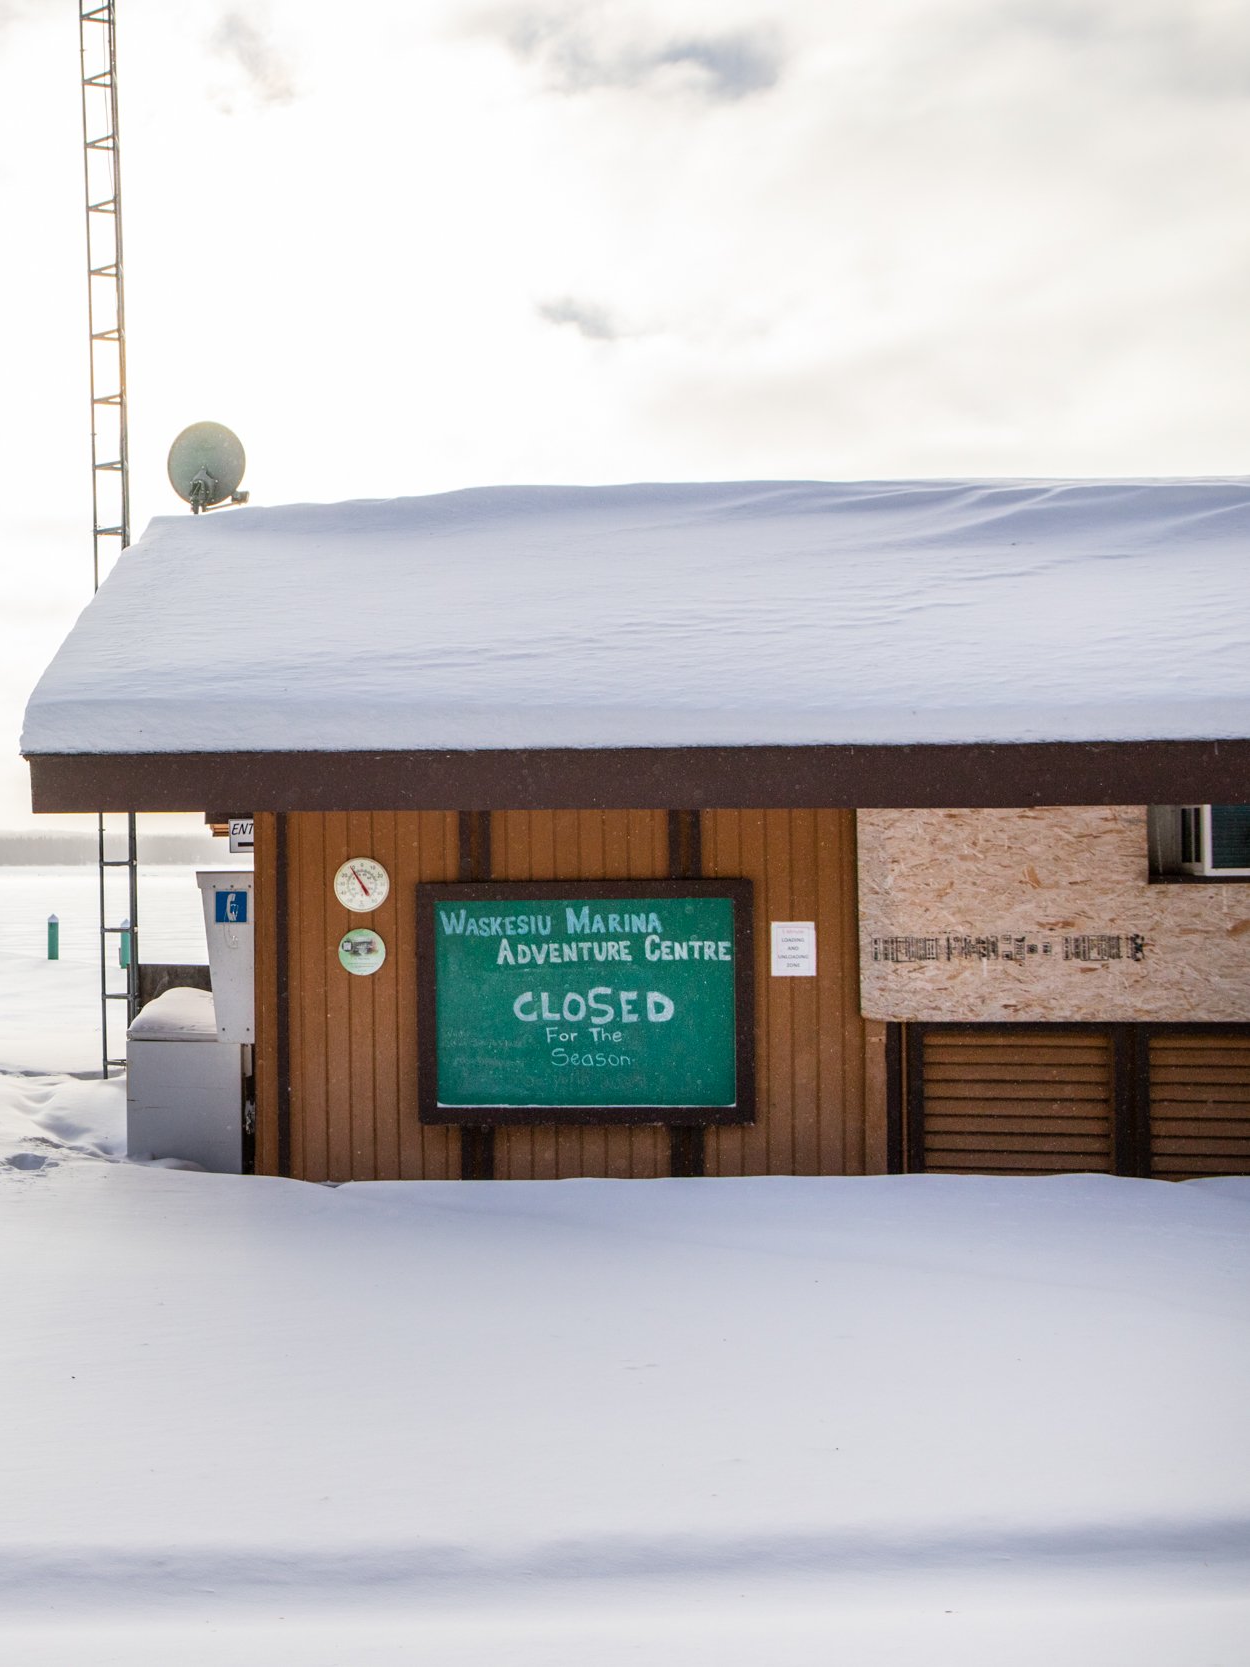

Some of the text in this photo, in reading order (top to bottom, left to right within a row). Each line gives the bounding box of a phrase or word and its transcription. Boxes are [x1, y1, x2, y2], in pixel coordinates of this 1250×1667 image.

[439, 906, 664, 936] WASKESIU MARINA
[496, 934, 731, 965] ADVENTURE CENTRE
[513, 987, 674, 1025] CLOSED
[546, 1027, 622, 1043] For The
[551, 1048, 631, 1067] Season
